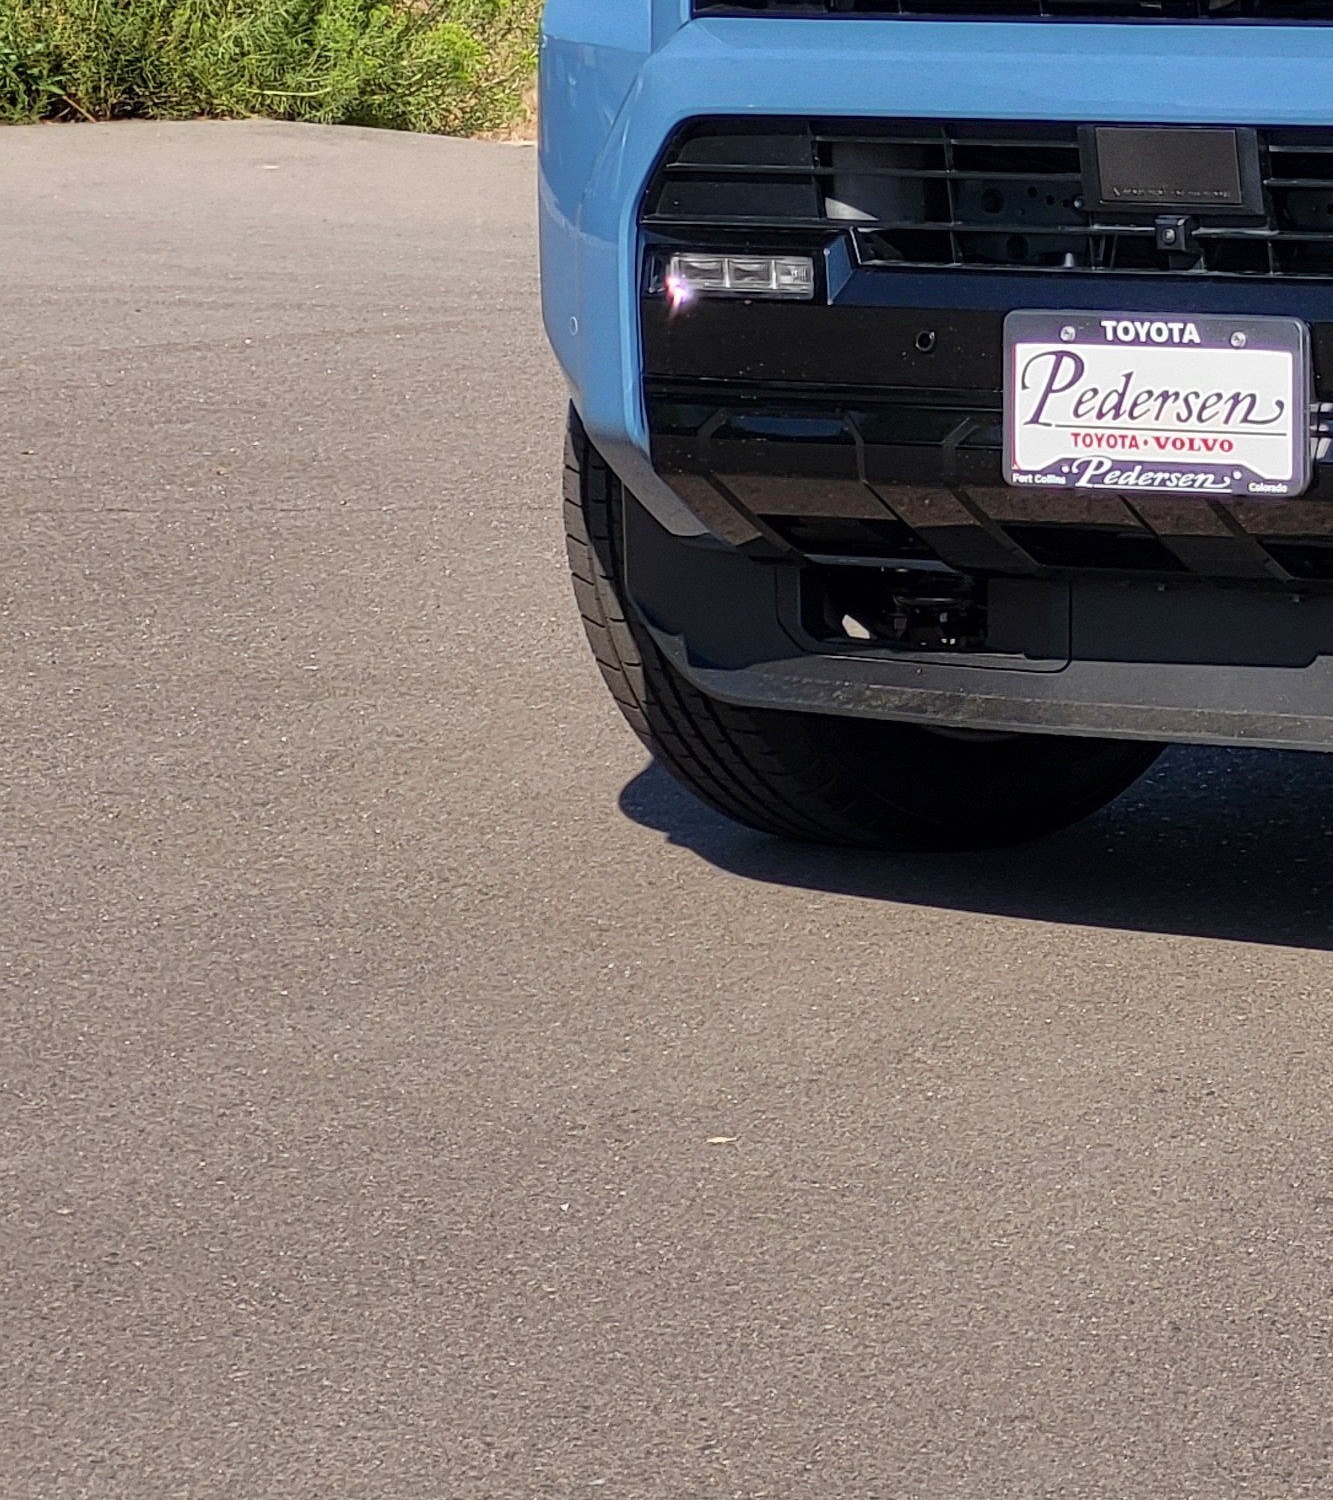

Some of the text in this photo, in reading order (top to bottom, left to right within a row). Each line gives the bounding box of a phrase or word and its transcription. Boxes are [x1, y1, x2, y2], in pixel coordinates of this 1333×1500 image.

[1100, 320, 1201, 344] TOYOTA
[1021, 350, 1285, 427] Pedersen
[1071, 432, 1234, 453] TOYOTA VOLVO
[1012, 472, 1066, 485] Fort Collins
[1071, 456, 1231, 488] Pedersen
[1248, 482, 1288, 494] Colorado
